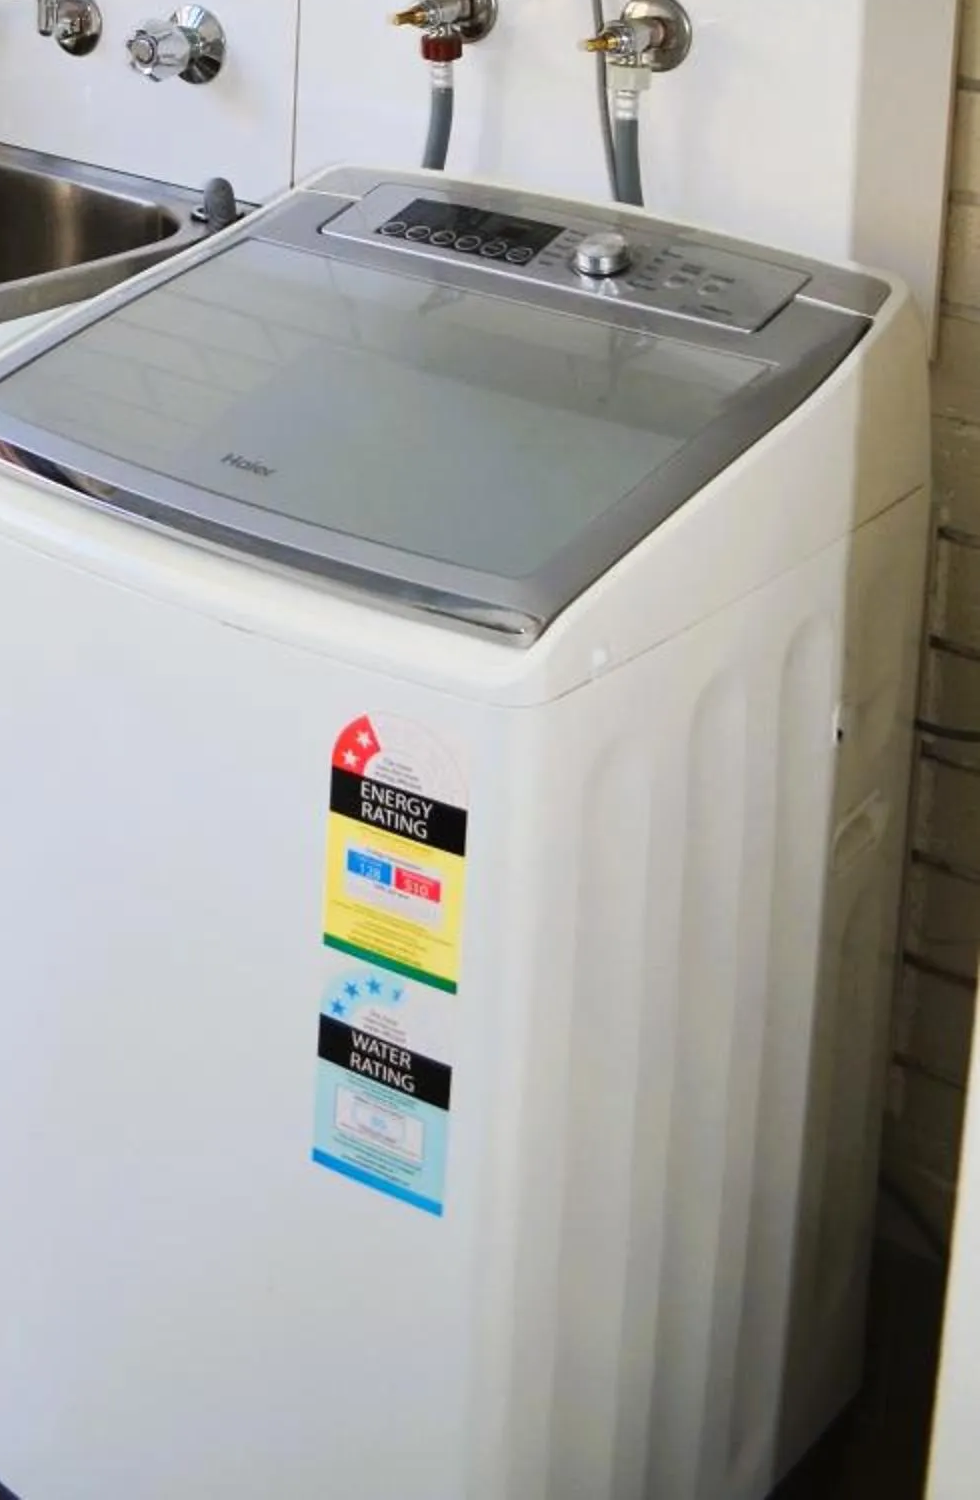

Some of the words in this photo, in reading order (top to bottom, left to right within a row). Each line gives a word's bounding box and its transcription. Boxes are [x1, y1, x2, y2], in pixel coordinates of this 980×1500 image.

[220, 452, 278, 477] Haier
[360, 780, 433, 819] ENERGY
[361, 802, 428, 840] RATING
[351, 1030, 412, 1069] WATER
[350, 1051, 416, 1093] RATING
